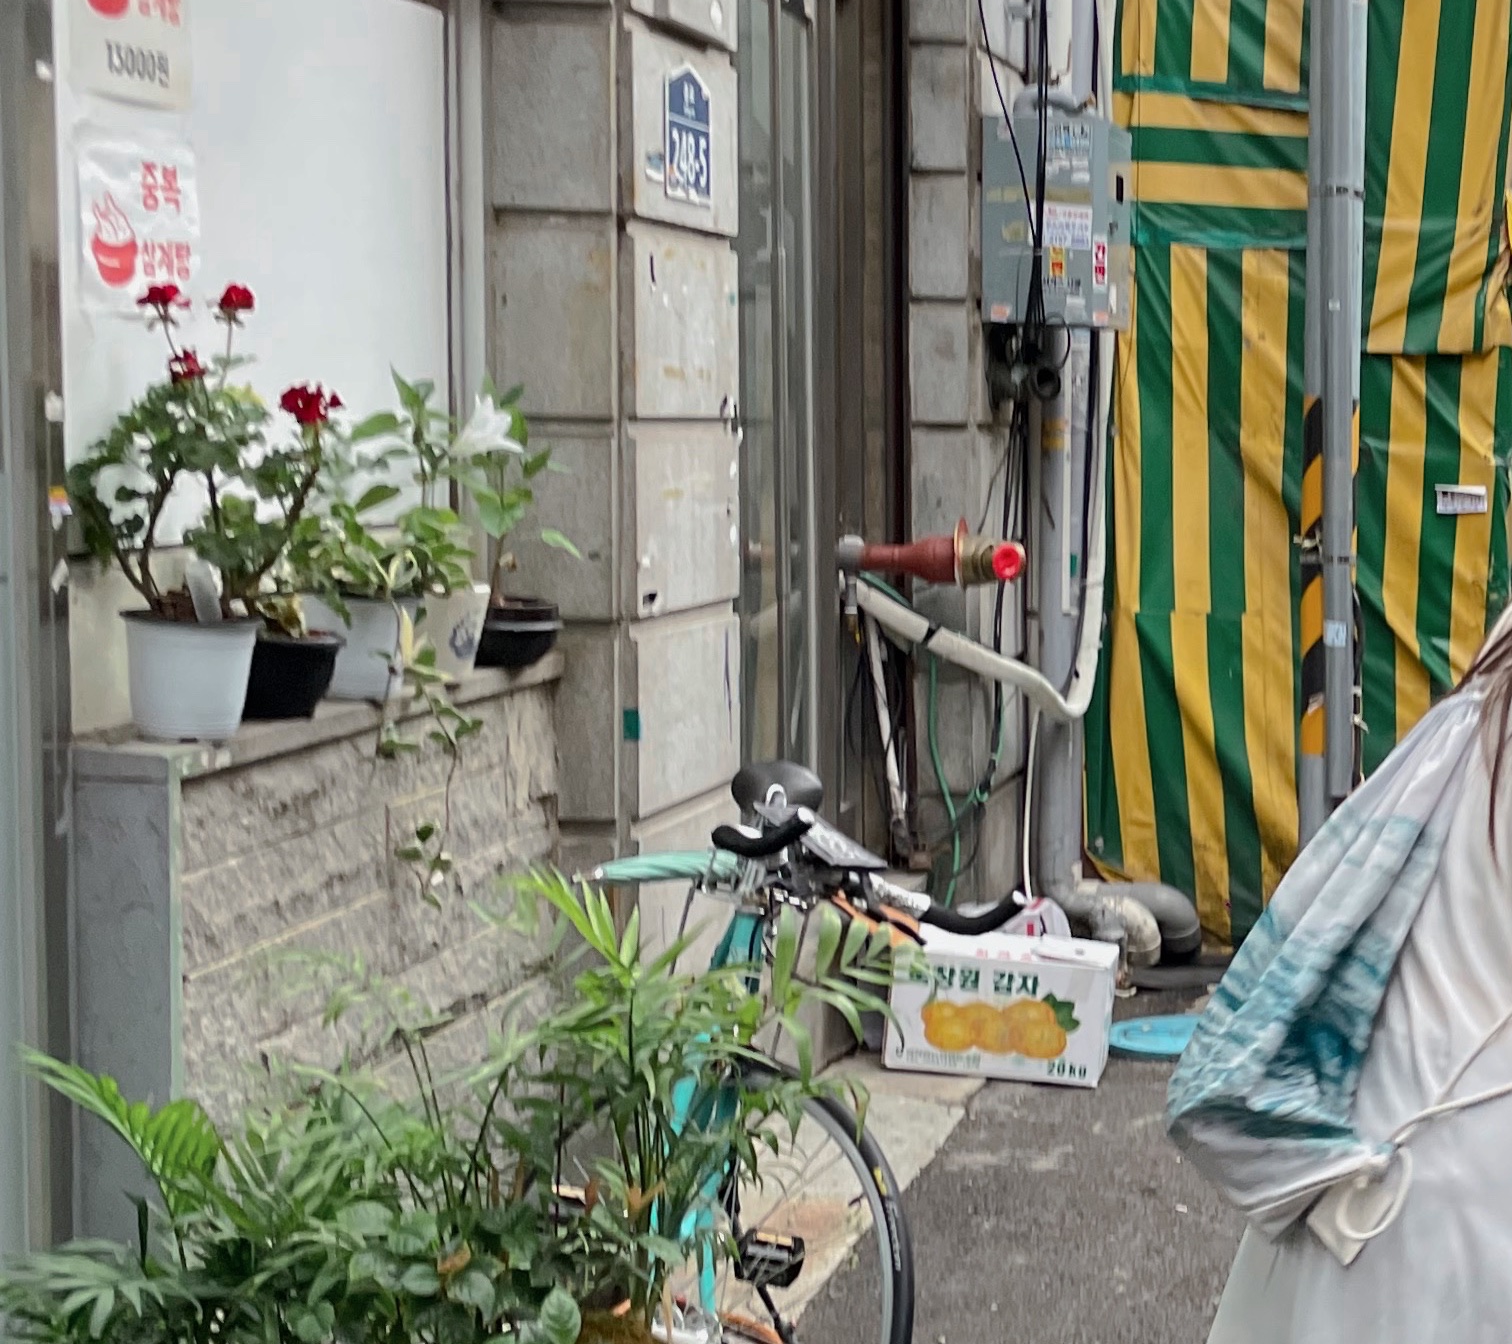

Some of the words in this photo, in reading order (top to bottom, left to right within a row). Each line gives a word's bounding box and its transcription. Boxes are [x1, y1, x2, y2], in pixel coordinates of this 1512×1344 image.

[670, 126, 708, 189] 248-5
[141, 160, 182, 217] 중복
[141, 239, 192, 282] 삼계탕
